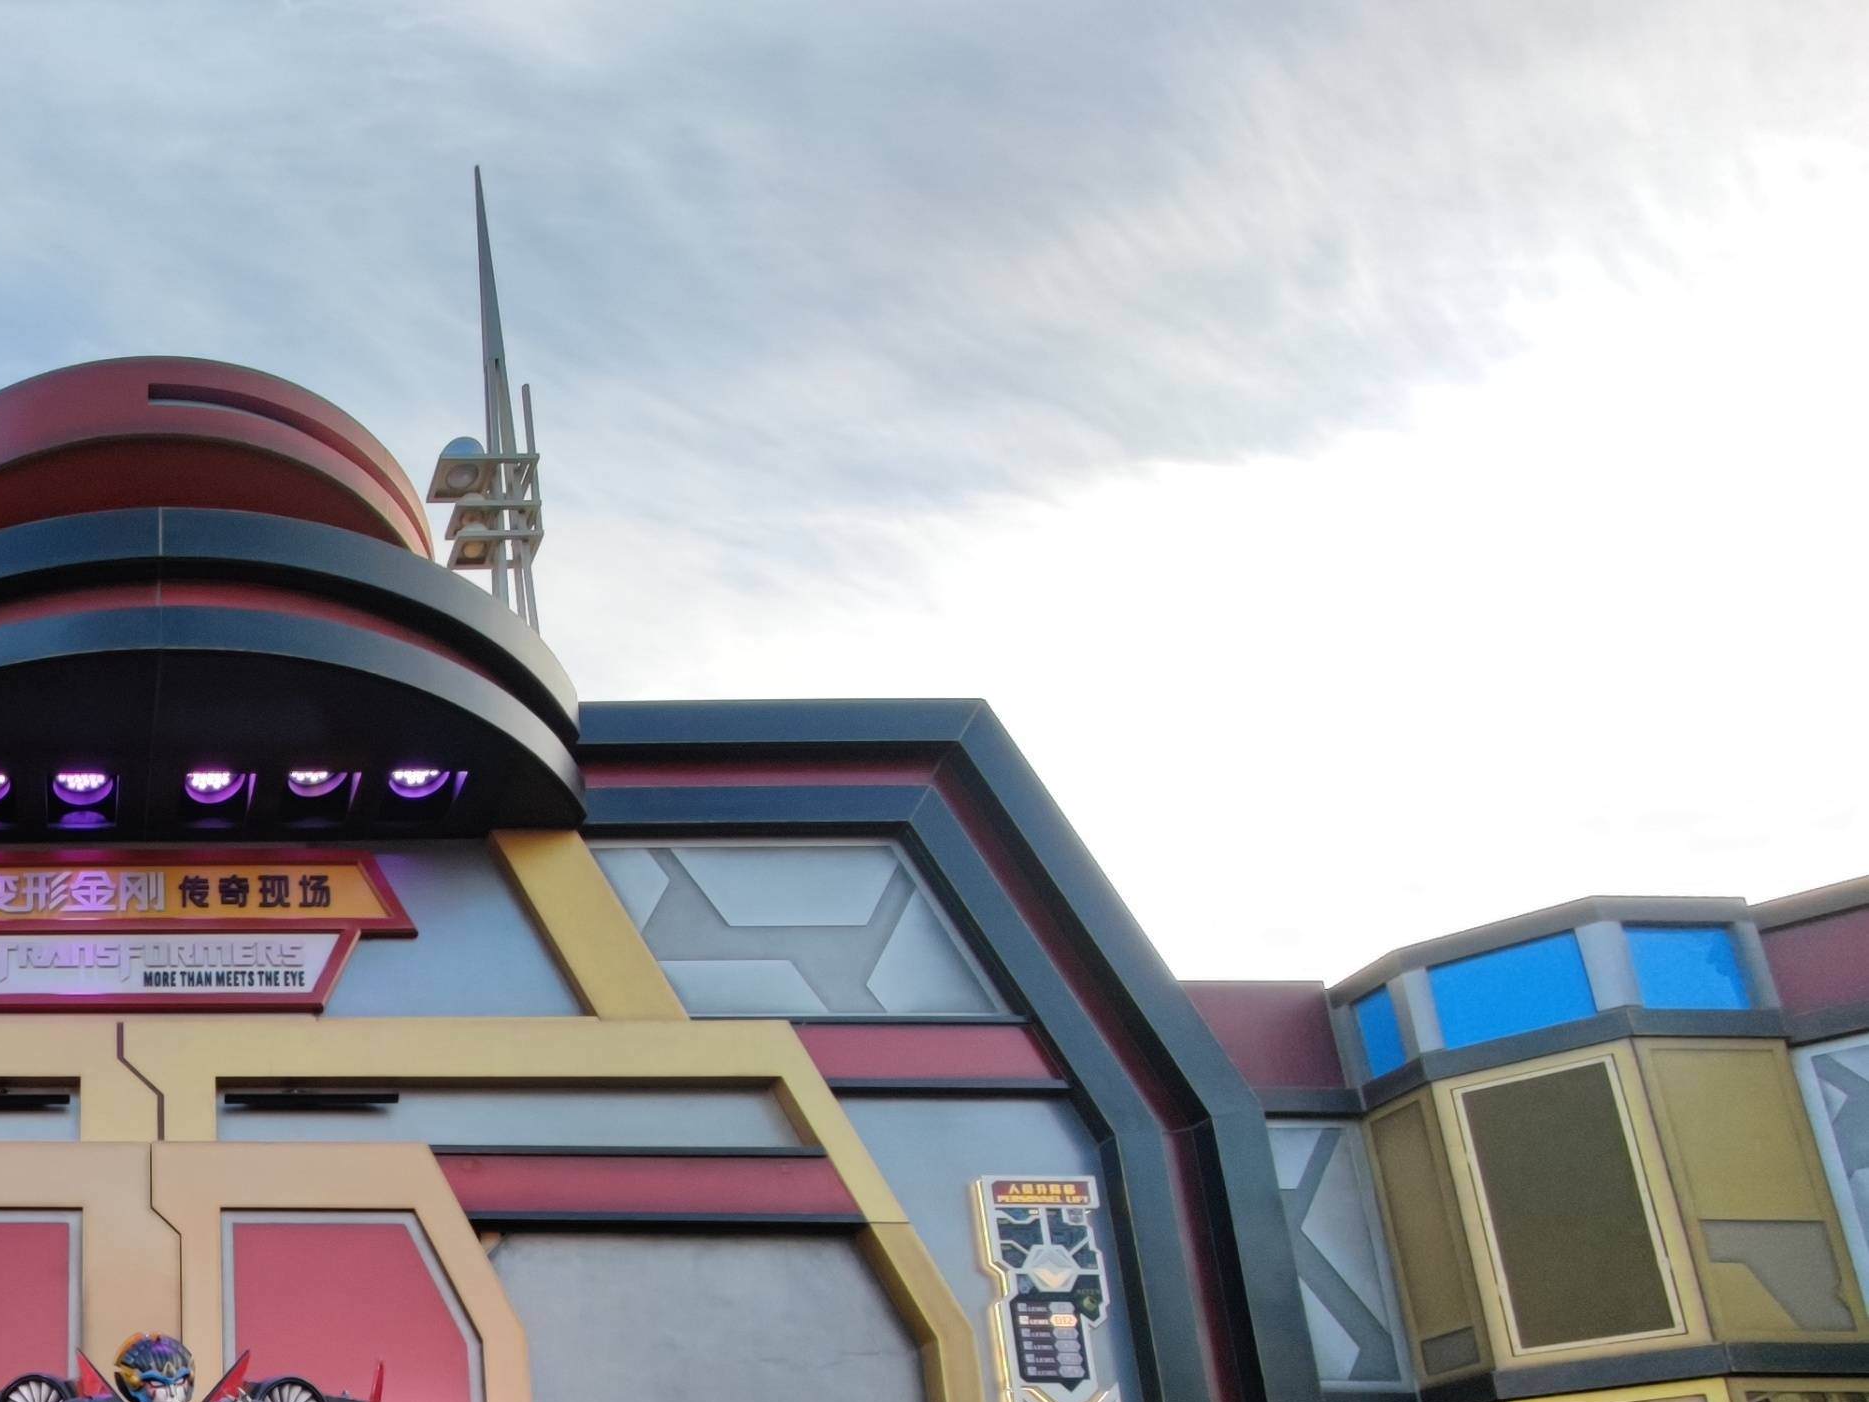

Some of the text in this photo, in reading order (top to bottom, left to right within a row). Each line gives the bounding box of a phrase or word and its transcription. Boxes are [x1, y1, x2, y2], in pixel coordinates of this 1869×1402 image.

[179, 874, 331, 908] 传奇现场
[143, 970, 306, 988] MORE THAN MEETS THE EYE
